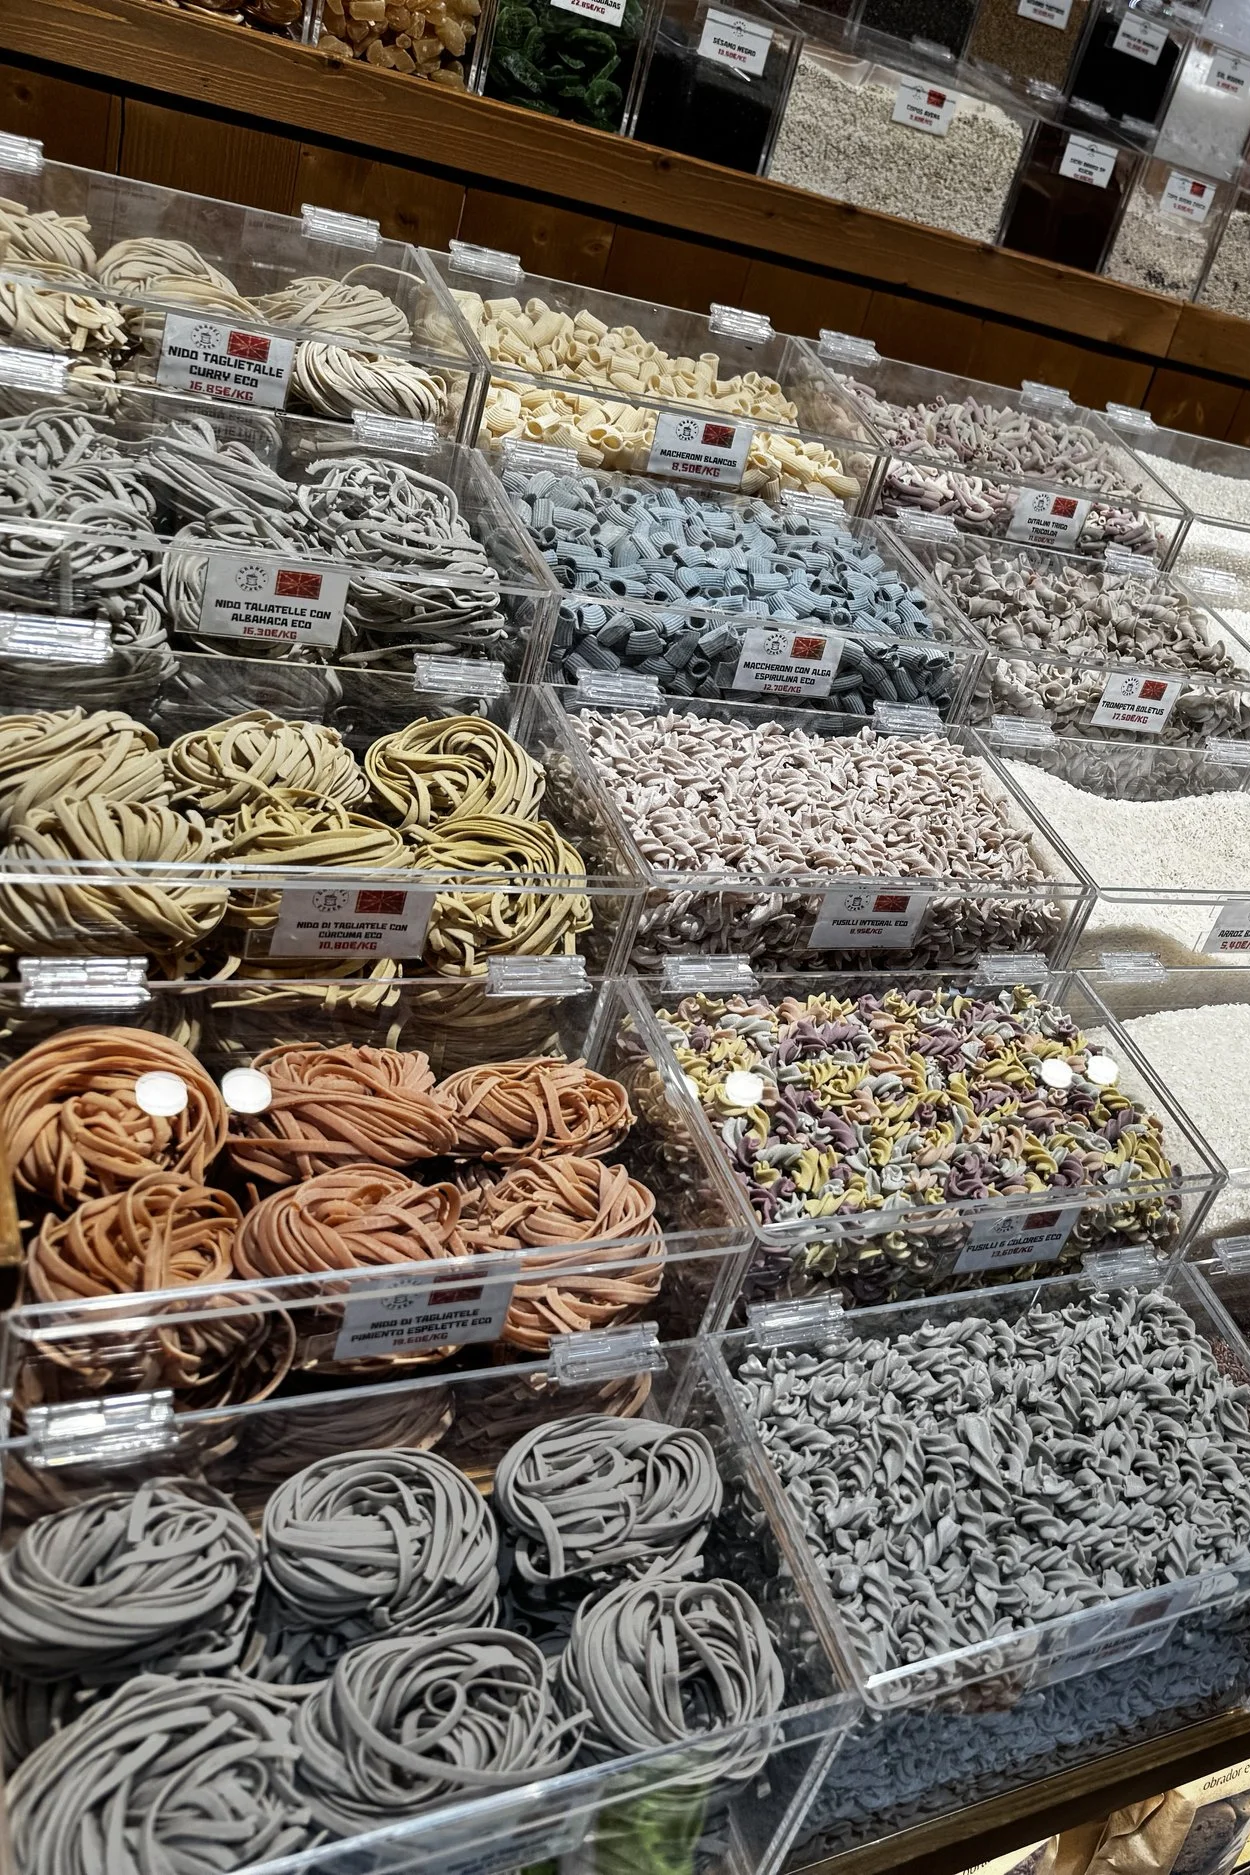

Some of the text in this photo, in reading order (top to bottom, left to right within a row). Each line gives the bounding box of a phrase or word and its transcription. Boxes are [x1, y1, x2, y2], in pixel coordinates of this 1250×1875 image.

[713, 37, 757, 57] SÉSAMO NEGRO
[168, 345, 285, 379] NIDO TAGLIETALLE
[189, 364, 259, 389] CURRY ECO
[189, 381, 254, 402] 16.85€/KG
[660, 449, 738, 468] MACHERONI BLANCOS
[671, 462, 721, 478] 8.50€/KG
[1051, 522, 1068, 531] TRIGO
[215, 599, 332, 620] NIDO TALIATELLE CON
[231, 612, 313, 630] ALBAHACA ECO
[242, 626, 298, 641] 16.30€/KG
[743, 662, 832, 678] MACCHERONI CON ALGA
[754, 673, 816, 686] ESPIRULINA ECO
[763, 685, 802, 695] 12.70€/KG
[1101, 701, 1165, 716] TROMPETA BOLETUS
[1112, 712, 1148, 724] 17.50€/KG
[296, 921, 409, 932] NIDO DI TAGLIATELE CON
[832, 919, 909, 928] FUSILLI INTEGRAL ECO
[364, 931, 382, 940] ECO
[1218, 929, 1243, 938] ARROZ
[318, 940, 377, 952] 10.80€/KG
[966, 1241, 998, 1254] FUSILLI
[1006, 1236, 1045, 1249] COLORES
[1044, 1233, 1062, 1242] ECO
[370, 1309, 480, 1331] NIDO DI TAGLIATELE
[351, 1317, 493, 1343] PIMIENTO ESPELETTE ECO
[1203, 1766, 1243, 1792] obrador
